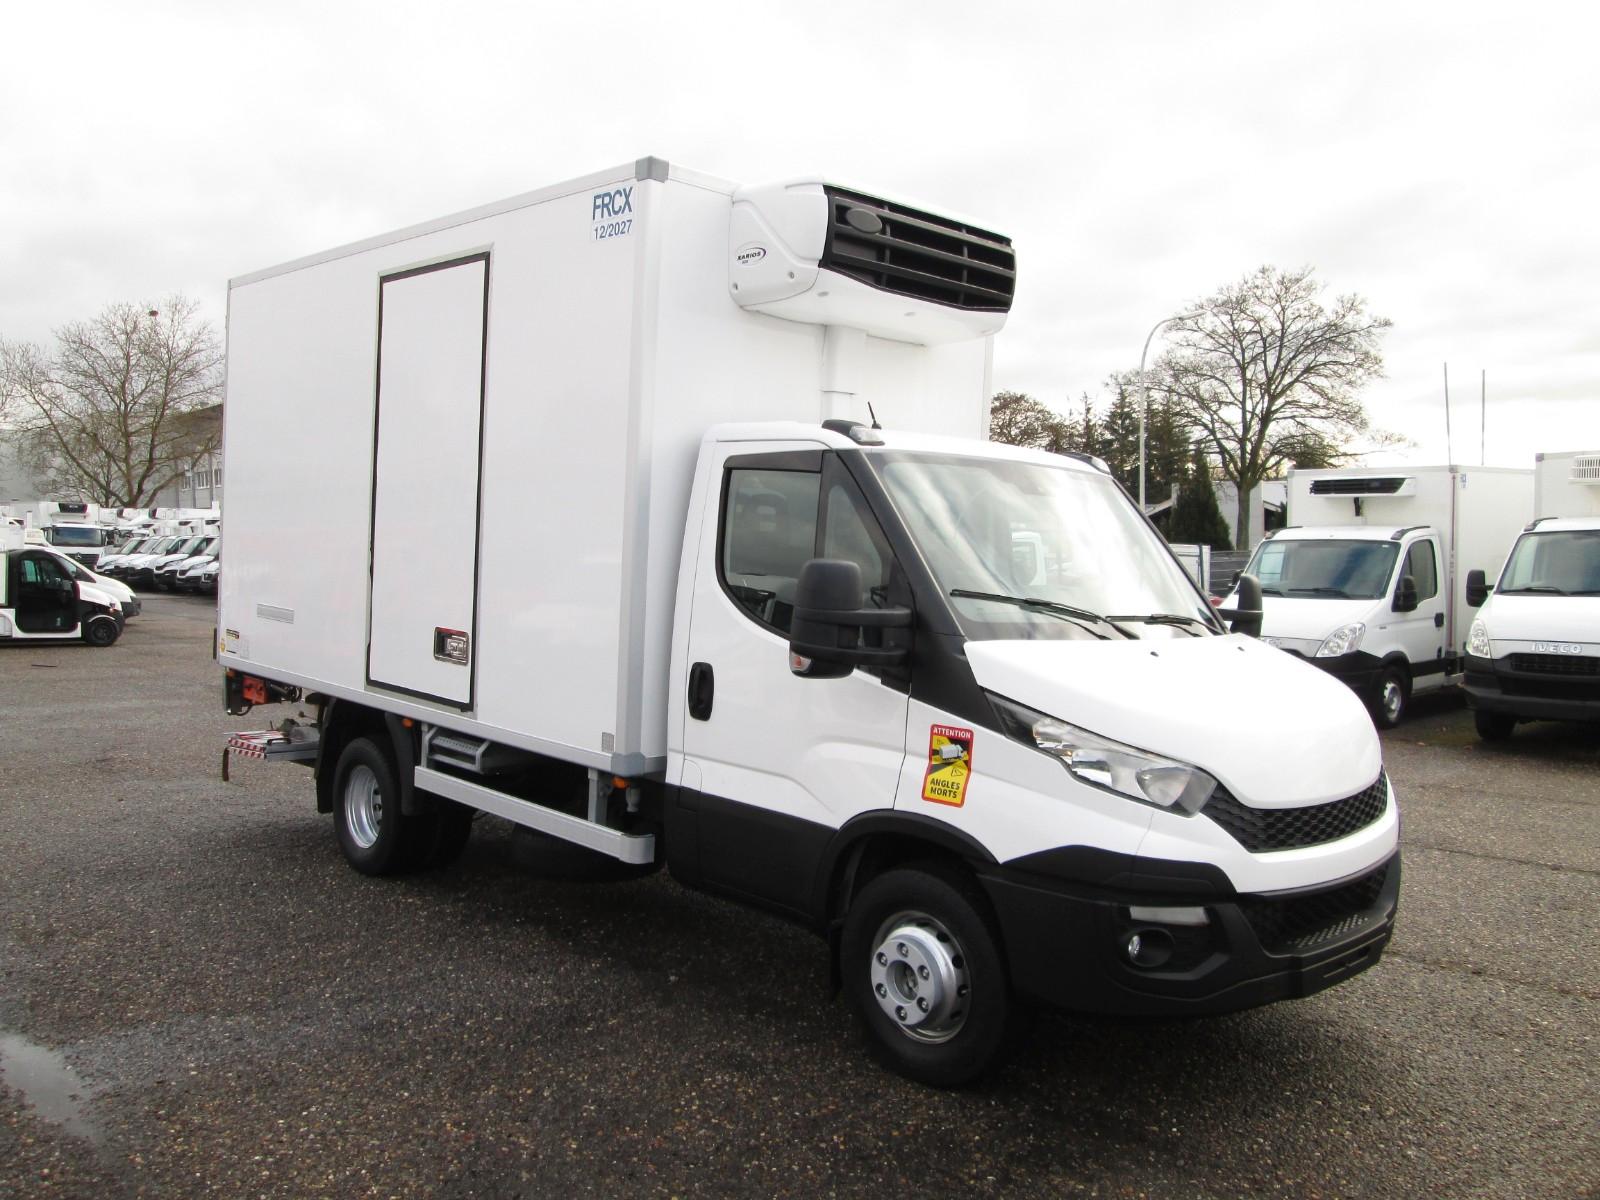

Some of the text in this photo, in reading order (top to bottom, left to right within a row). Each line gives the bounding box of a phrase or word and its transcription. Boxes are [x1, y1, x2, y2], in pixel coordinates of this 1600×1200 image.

[593, 186, 632, 220] FRCX
[594, 219, 632, 240] 12/2027
[737, 251, 761, 261] XARIOS
[1530, 642, 1582, 653] IVECO
[934, 727, 970, 738] ATTENTION
[930, 778, 960, 790] ANGLES
[930, 786, 957, 798] MORTS
